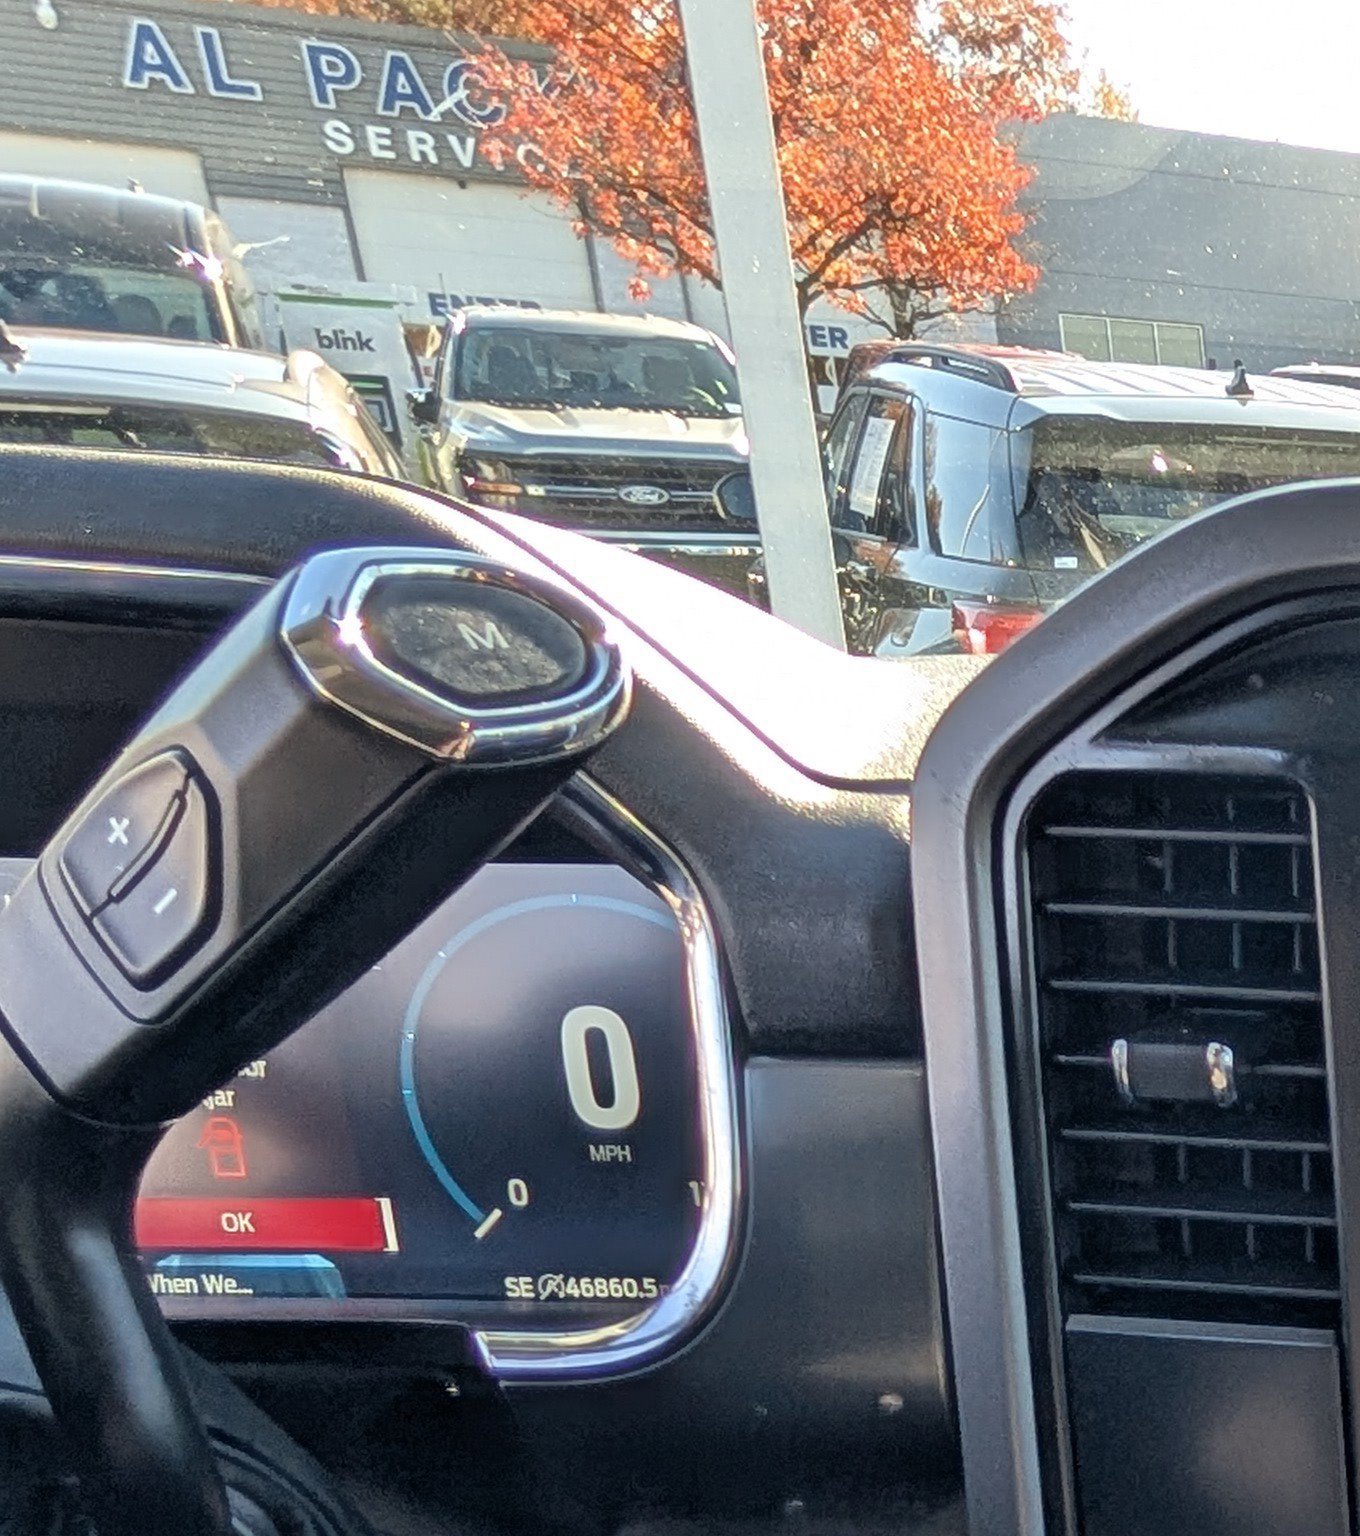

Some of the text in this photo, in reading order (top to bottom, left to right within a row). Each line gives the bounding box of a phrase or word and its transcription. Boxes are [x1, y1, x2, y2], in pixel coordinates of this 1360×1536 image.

[122, 17, 262, 101] AL
[313, 327, 376, 352] blink
[460, 619, 511, 653] M
[560, 1004, 641, 1131] 0
[588, 1144, 632, 1163] MPH
[507, 1178, 529, 1207] 0
[221, 1212, 256, 1234] OK
[504, 1276, 536, 1298] SE
[565, 1277, 658, 1299] 46860.5
